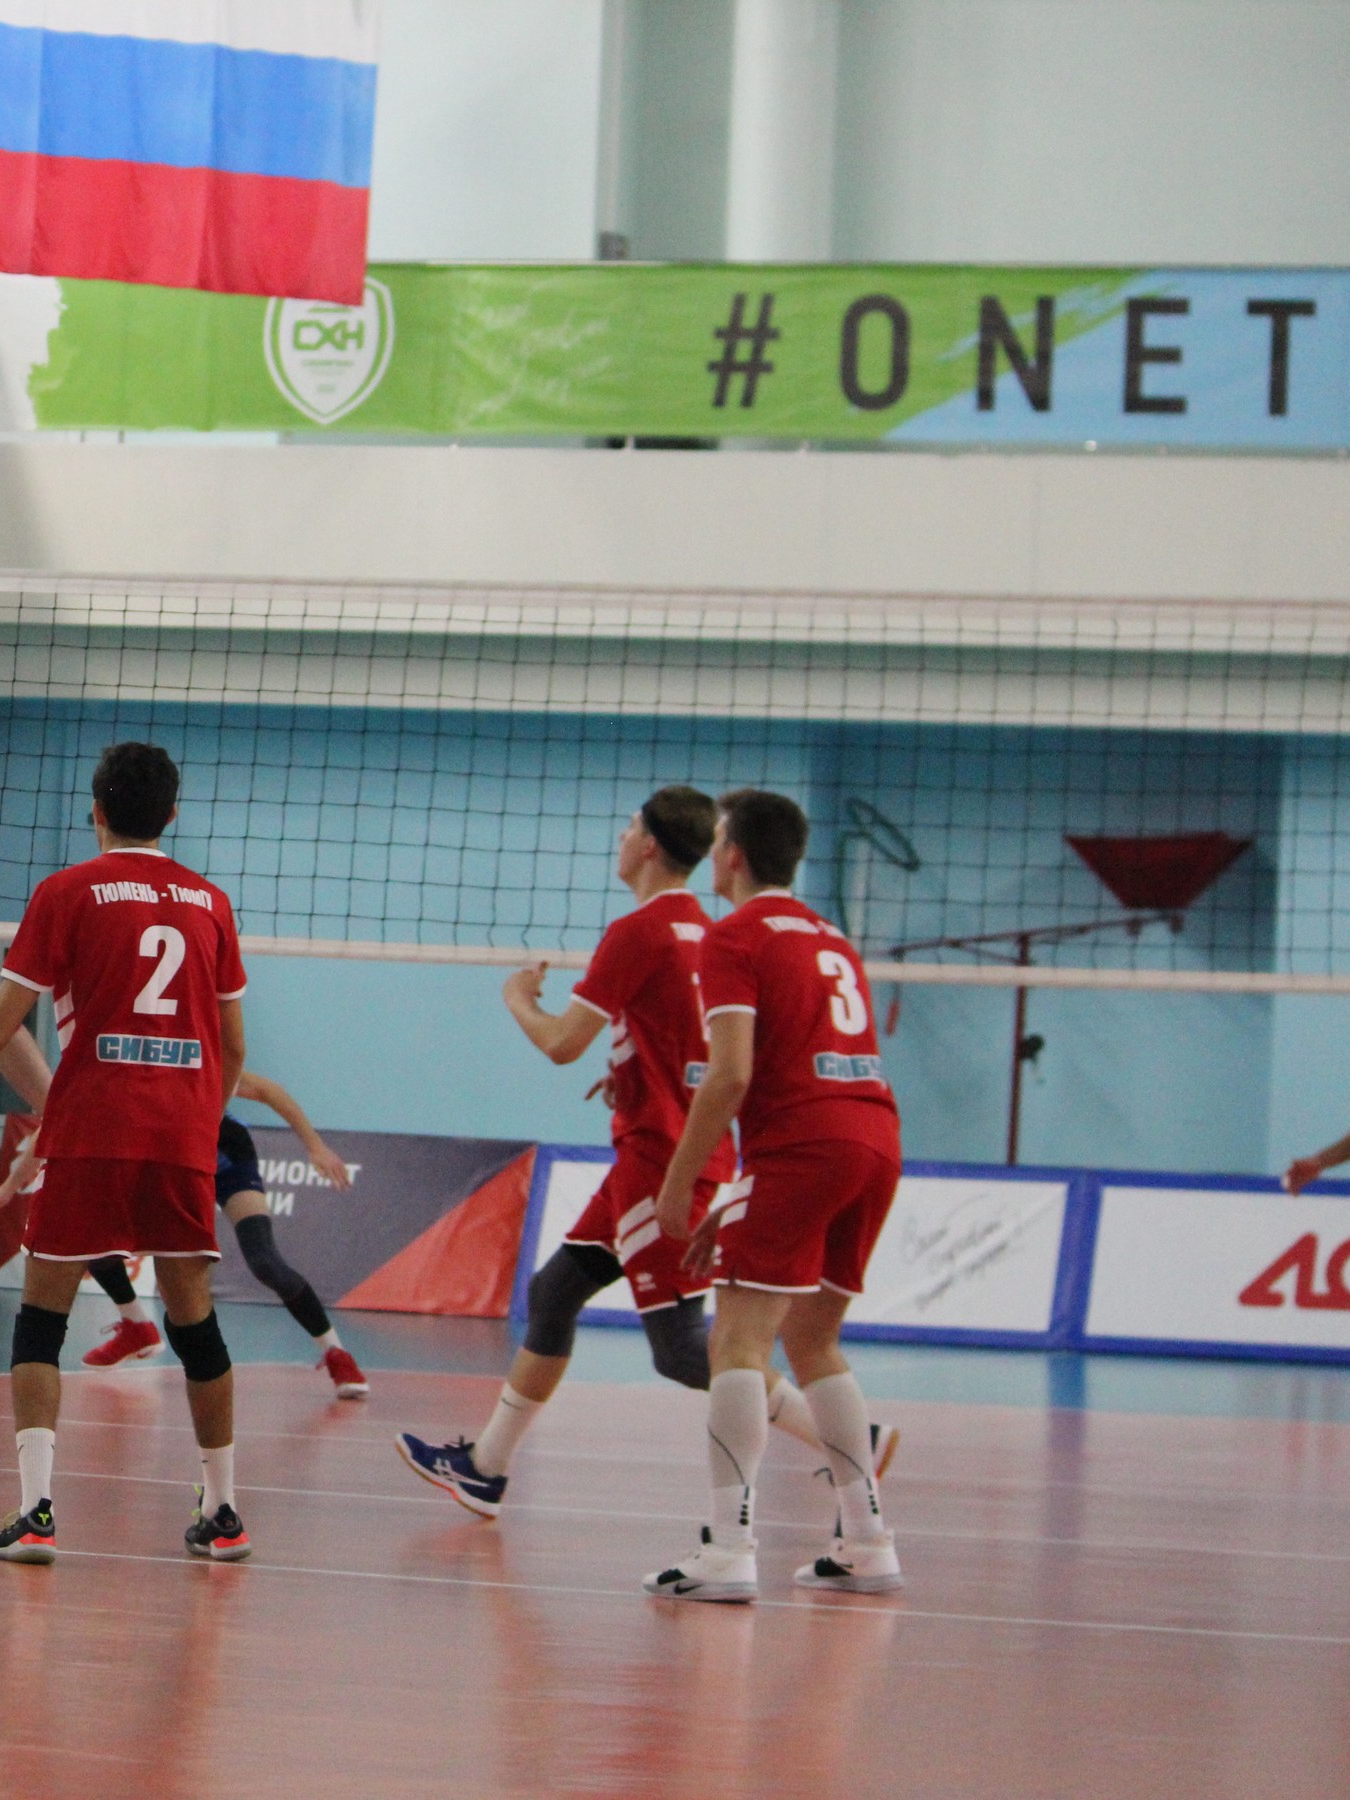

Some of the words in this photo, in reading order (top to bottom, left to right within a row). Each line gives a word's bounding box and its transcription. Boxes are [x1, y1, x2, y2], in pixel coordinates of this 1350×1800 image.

[90, 881, 159, 905] ТЮМЕНЬ
[133, 925, 186, 1015] 2
[817, 950, 868, 1035] 3
[99, 1036, 201, 1066] СИБУР
